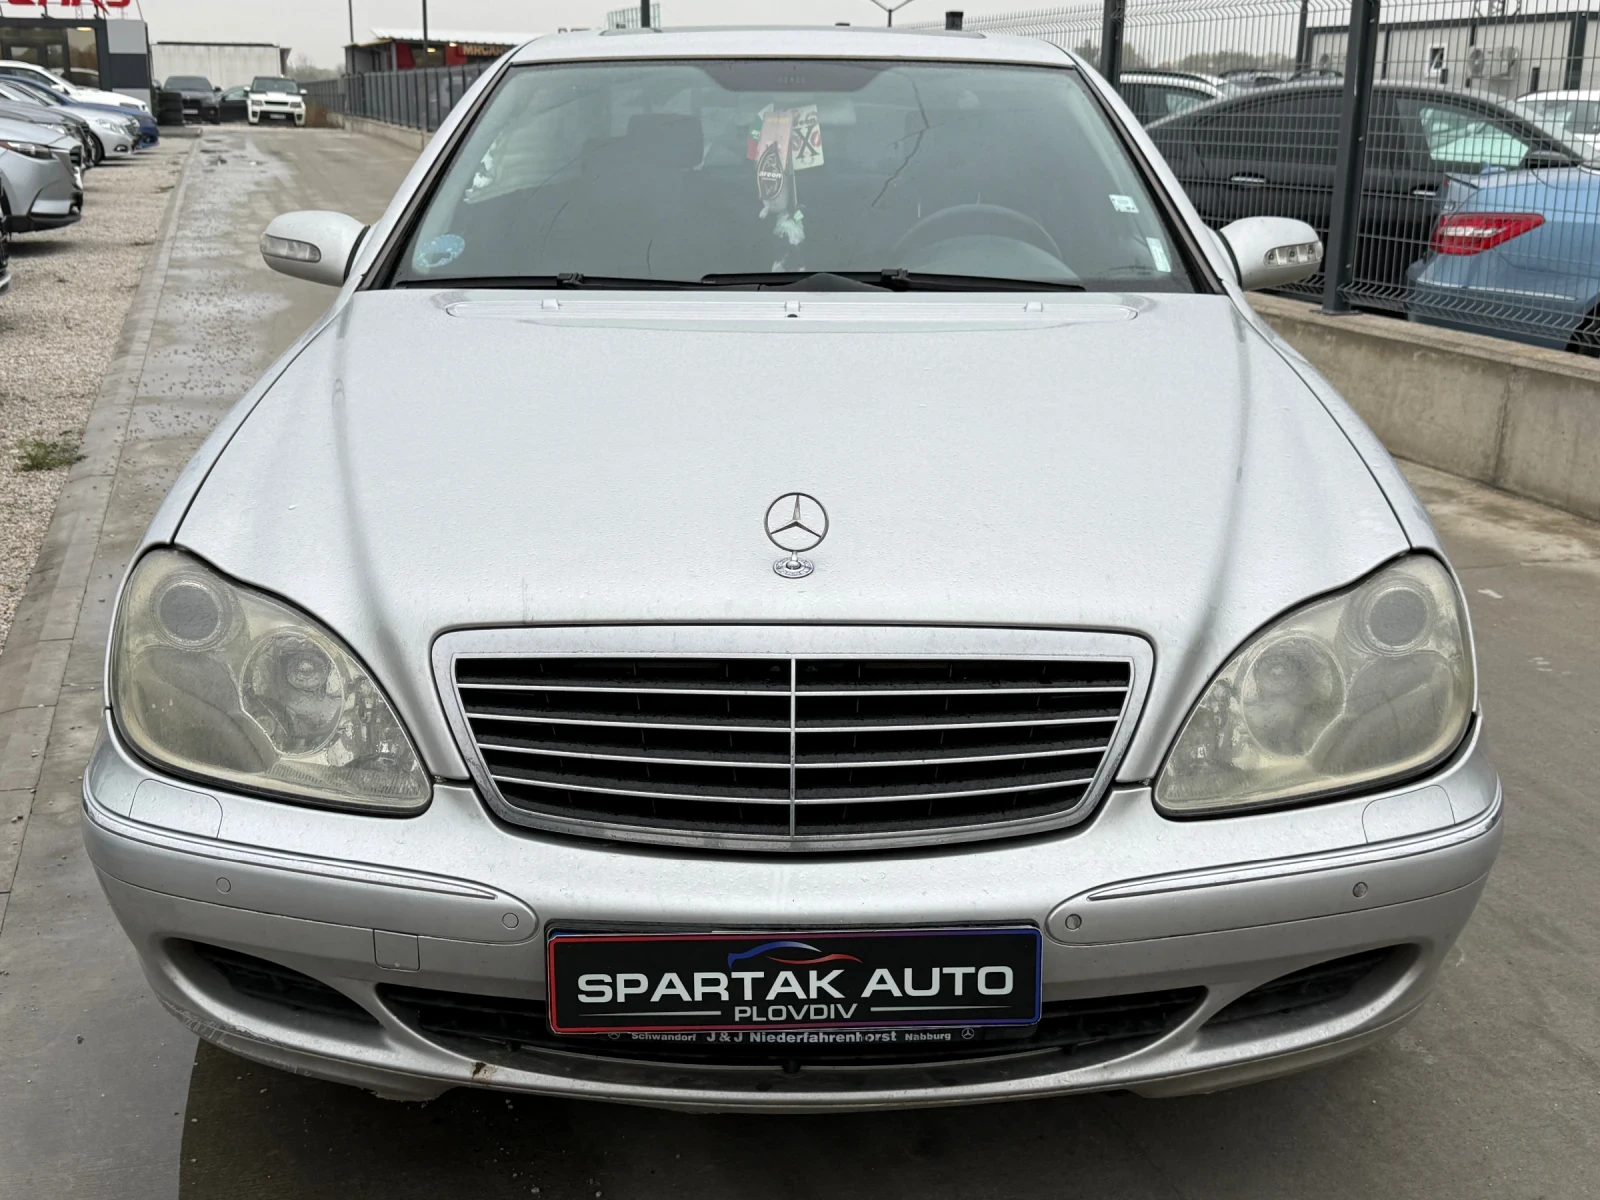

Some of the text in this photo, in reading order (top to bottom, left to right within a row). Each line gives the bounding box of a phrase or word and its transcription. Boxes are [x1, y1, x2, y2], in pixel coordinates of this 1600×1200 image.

[577, 965, 1014, 1003] SPARTAK AUTO
[734, 1003, 858, 1021] PLOVDIV
[631, 1032, 697, 1042] Schwandorf
[749, 1031, 897, 1043] Niederfahrenhorst
[904, 1032, 952, 1042] Nabburg
